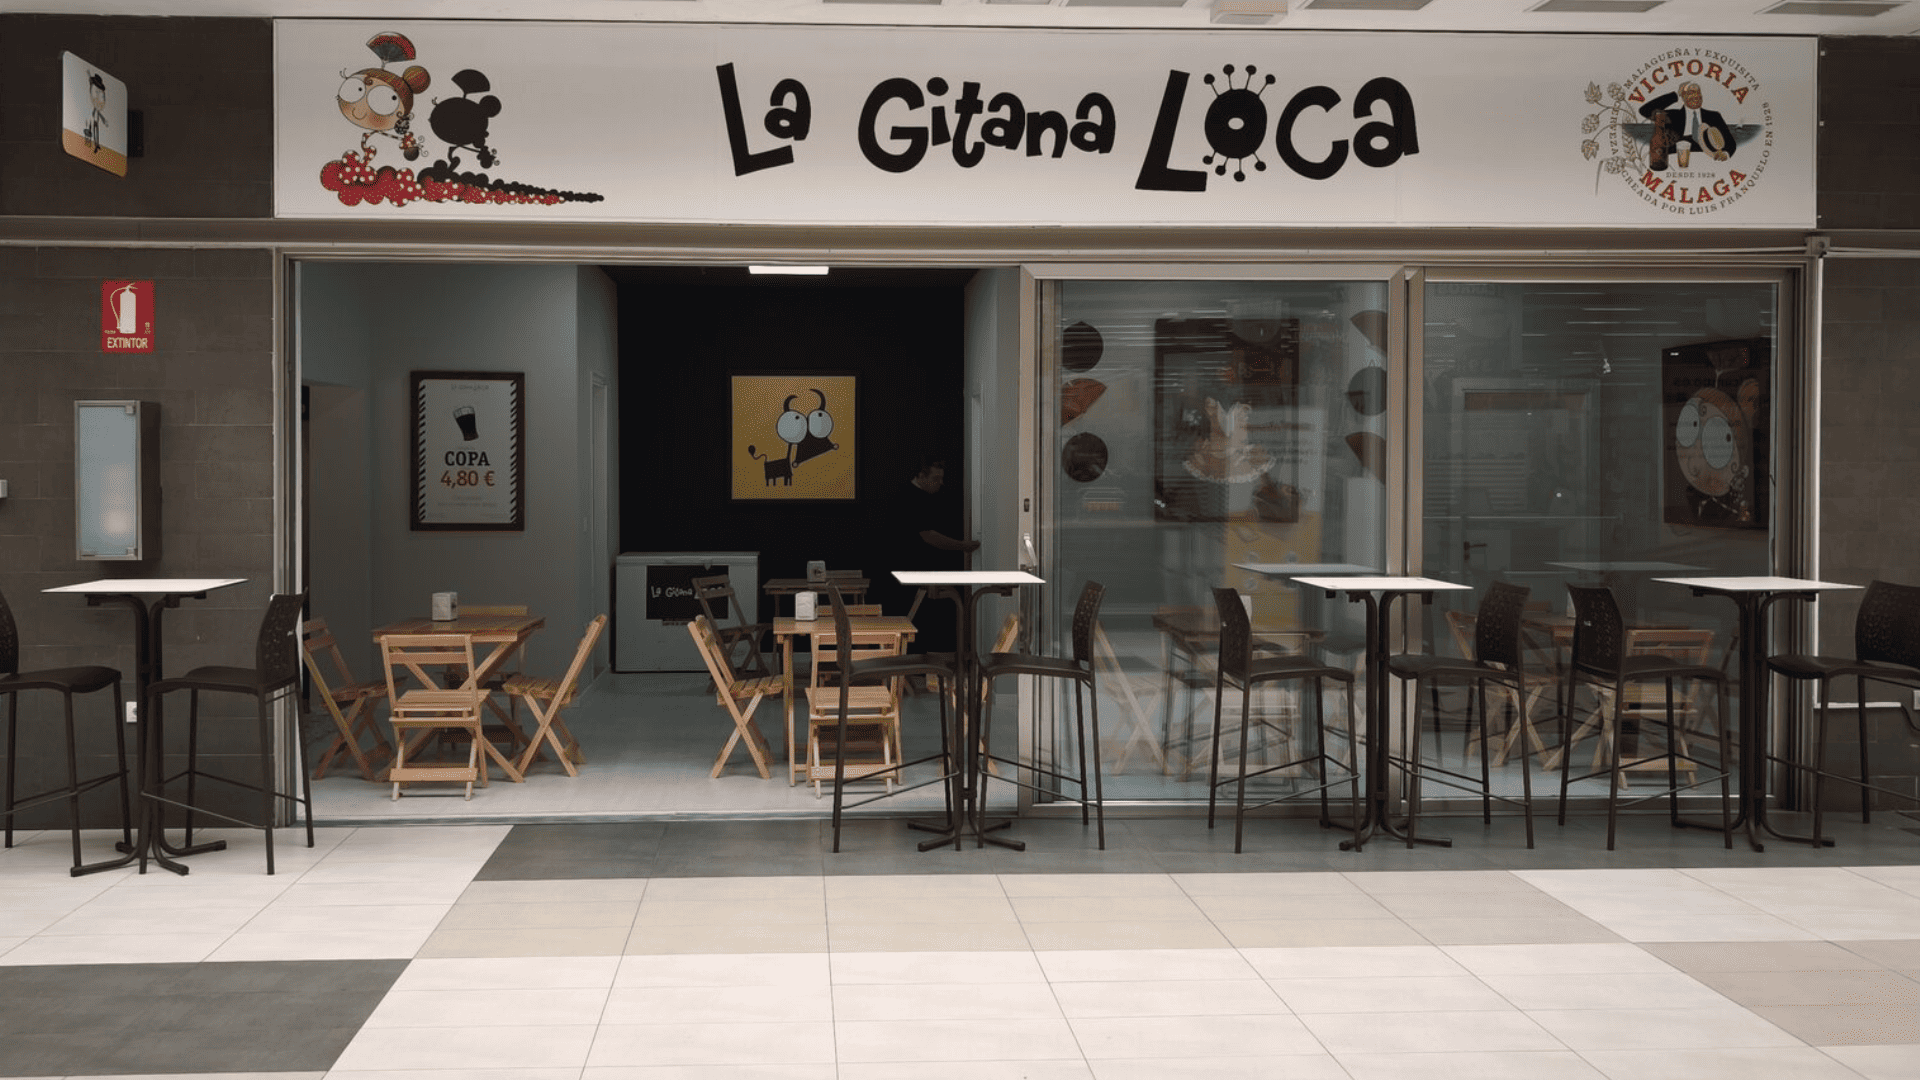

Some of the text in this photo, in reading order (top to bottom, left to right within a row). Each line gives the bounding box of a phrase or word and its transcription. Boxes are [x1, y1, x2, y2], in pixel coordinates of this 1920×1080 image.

[1623, 48, 1691, 89] MALAGUEÑA
[1694, 48, 1702, 56] Y
[1704, 49, 1760, 91] EXQUISITA
[1628, 59, 1749, 105] VICTORIA
[716, 62, 811, 177] La
[858, 77, 1116, 173] Gitana
[1621, 170, 1658, 206] CREADA
[1661, 202, 1685, 215] POR
[1689, 203, 1718, 215] LUIS
[1720, 150, 1770, 208] FRANQUELO
[1639, 168, 1747, 204] MÁLAGA
[1666, 171, 1695, 179] DESDE
[107, 337, 149, 349] EXTINTOR
[444, 450, 491, 467] COPA
[440, 470, 496, 489] 4,80 €
